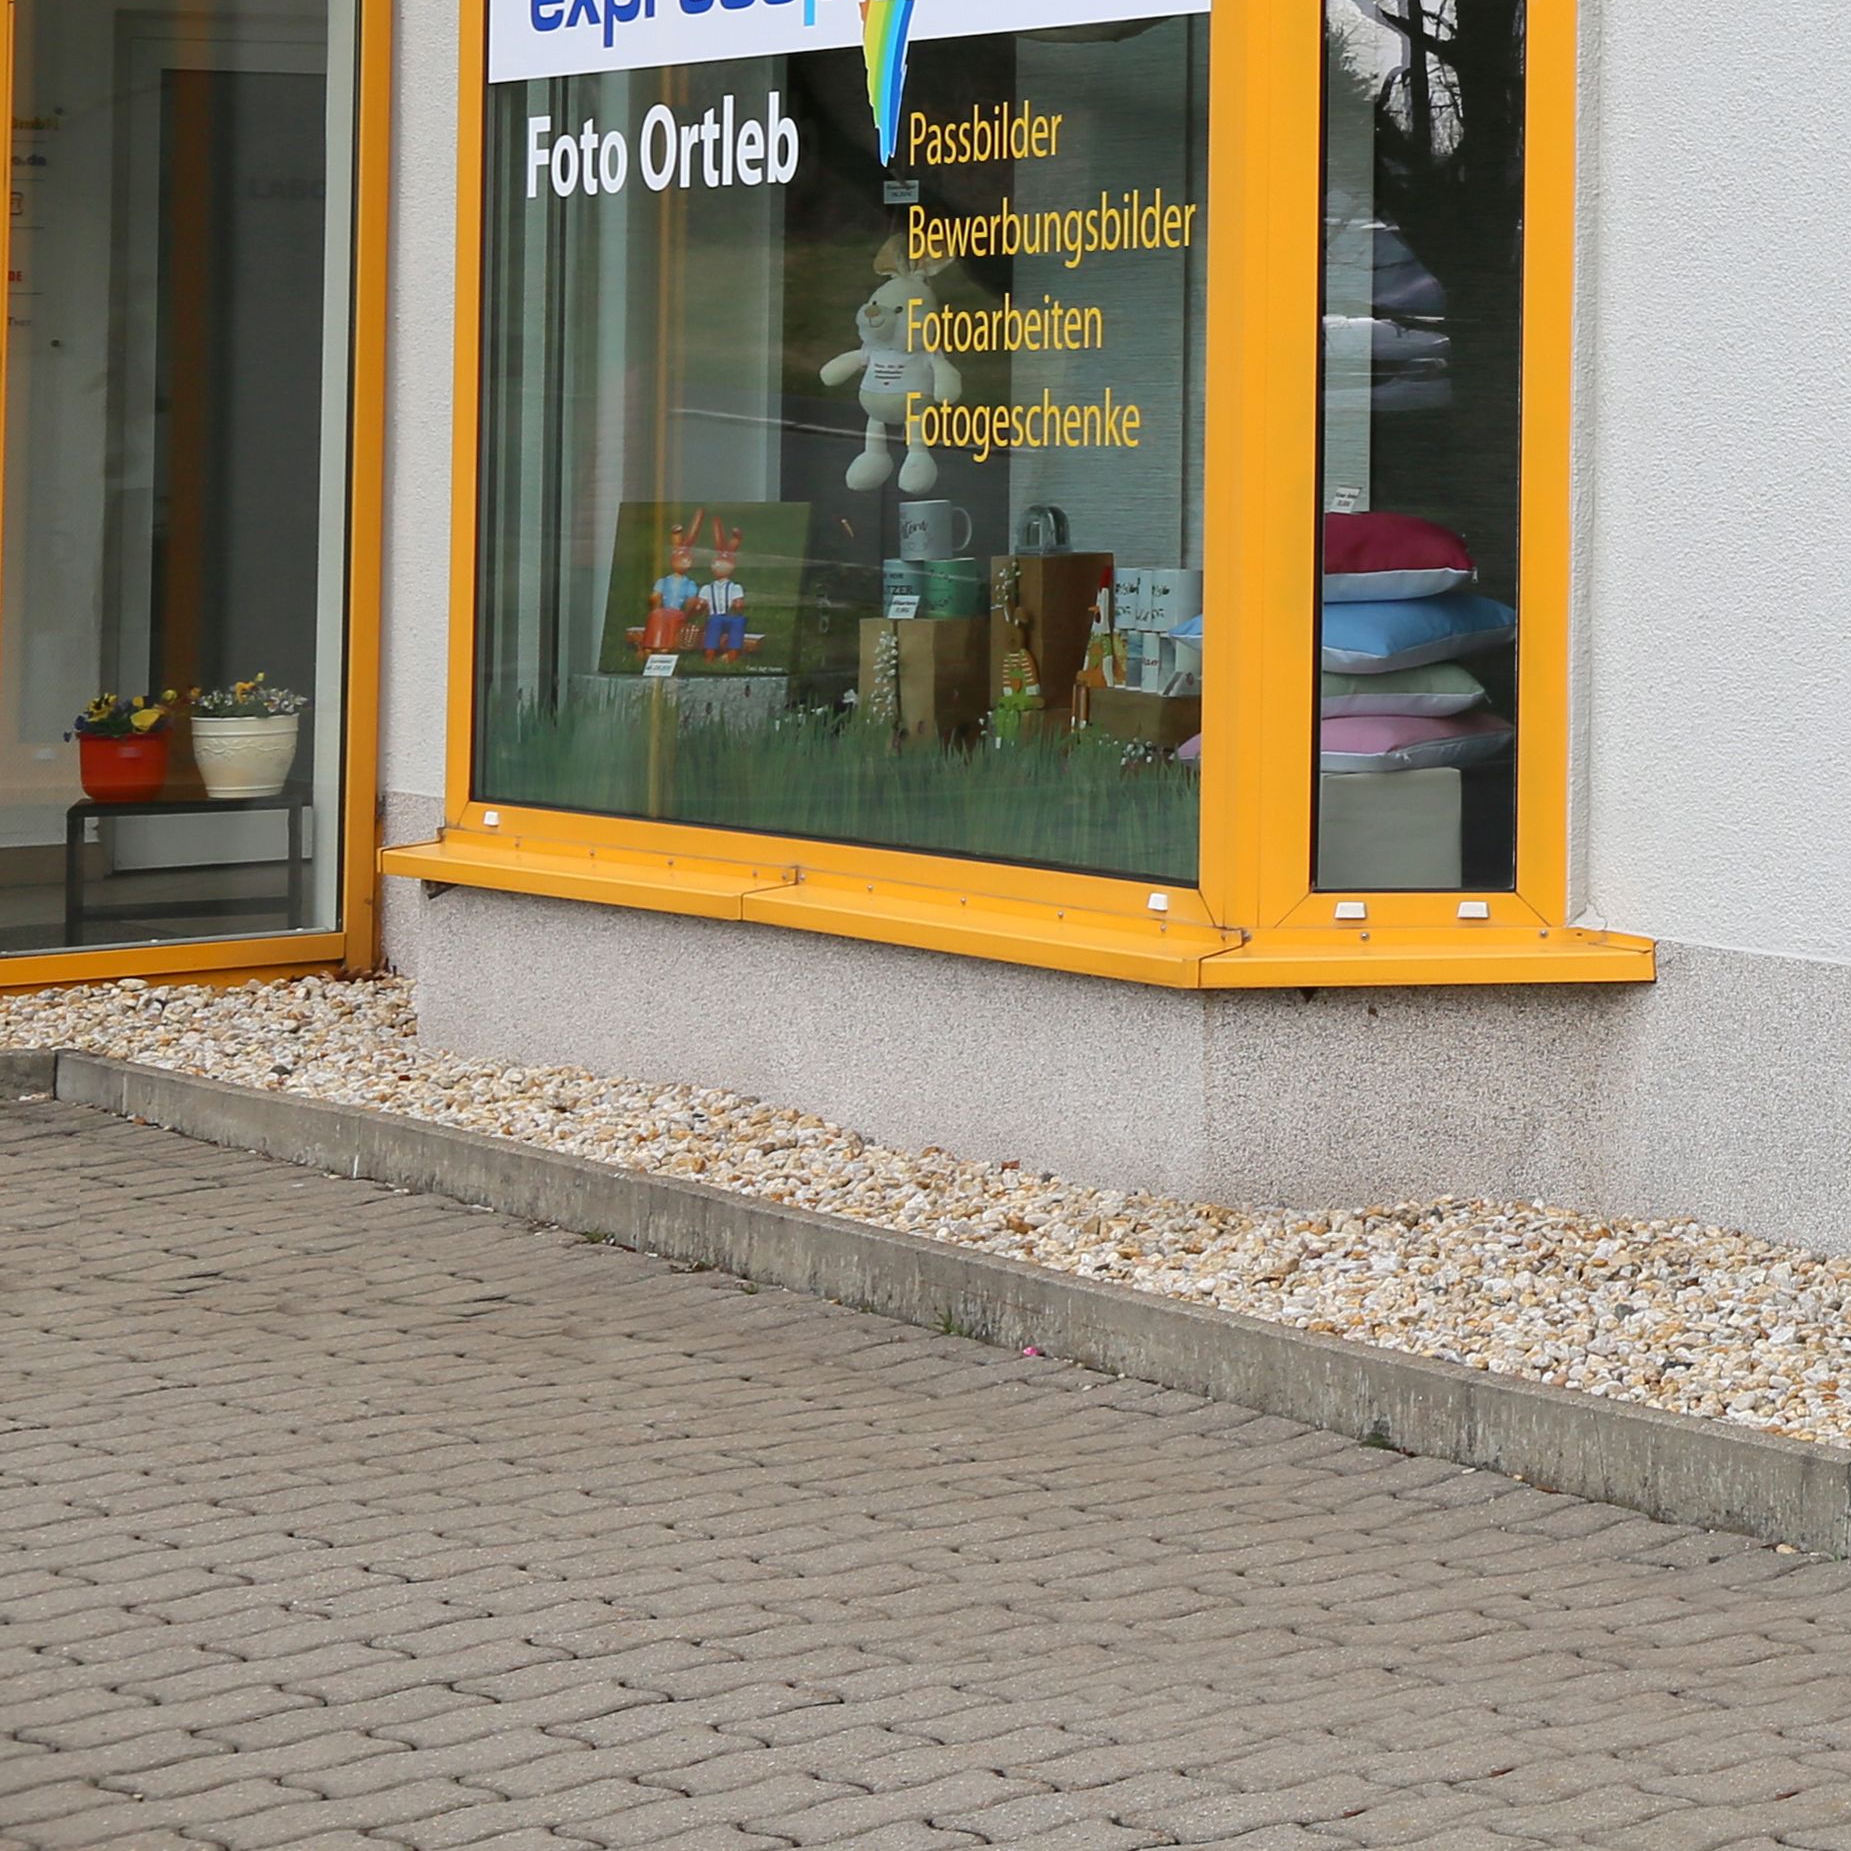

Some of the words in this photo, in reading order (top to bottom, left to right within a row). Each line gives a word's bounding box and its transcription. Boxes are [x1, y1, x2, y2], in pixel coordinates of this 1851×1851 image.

[526, 115, 629, 199] Foto
[639, 91, 799, 190] Ortleb
[909, 100, 1062, 166] Passbilder
[908, 188, 1197, 268] Bewerbungsbilder
[907, 292, 1104, 354] Fotoarbeiten
[905, 387, 1141, 463] Fotogeschenke
